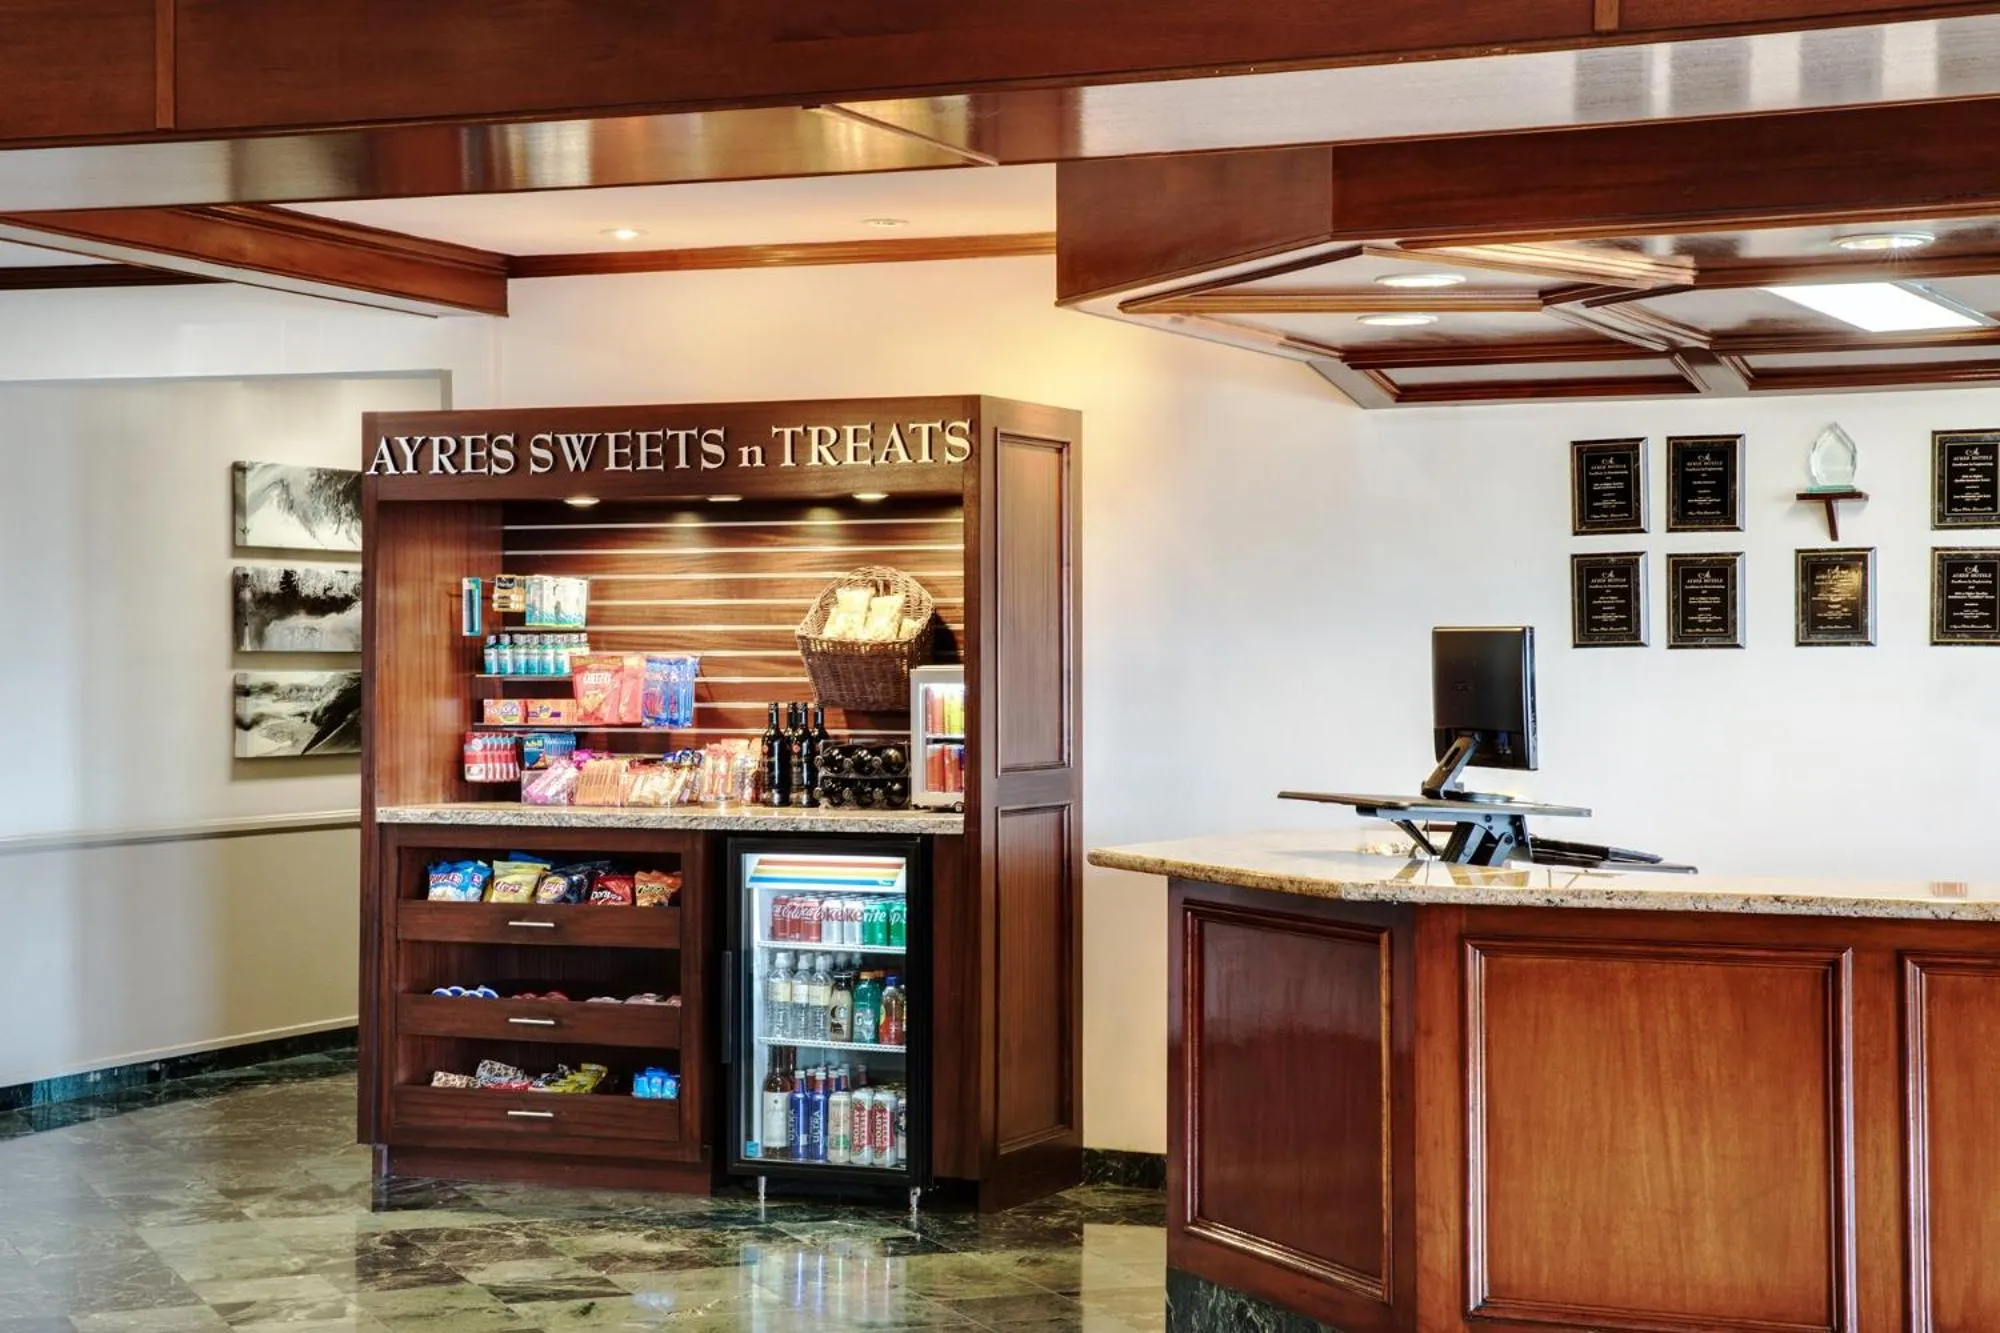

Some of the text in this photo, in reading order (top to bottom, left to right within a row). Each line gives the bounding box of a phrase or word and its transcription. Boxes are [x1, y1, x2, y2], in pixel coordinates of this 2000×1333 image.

[366, 419, 974, 475] AYRES SWEETS n TREATS
